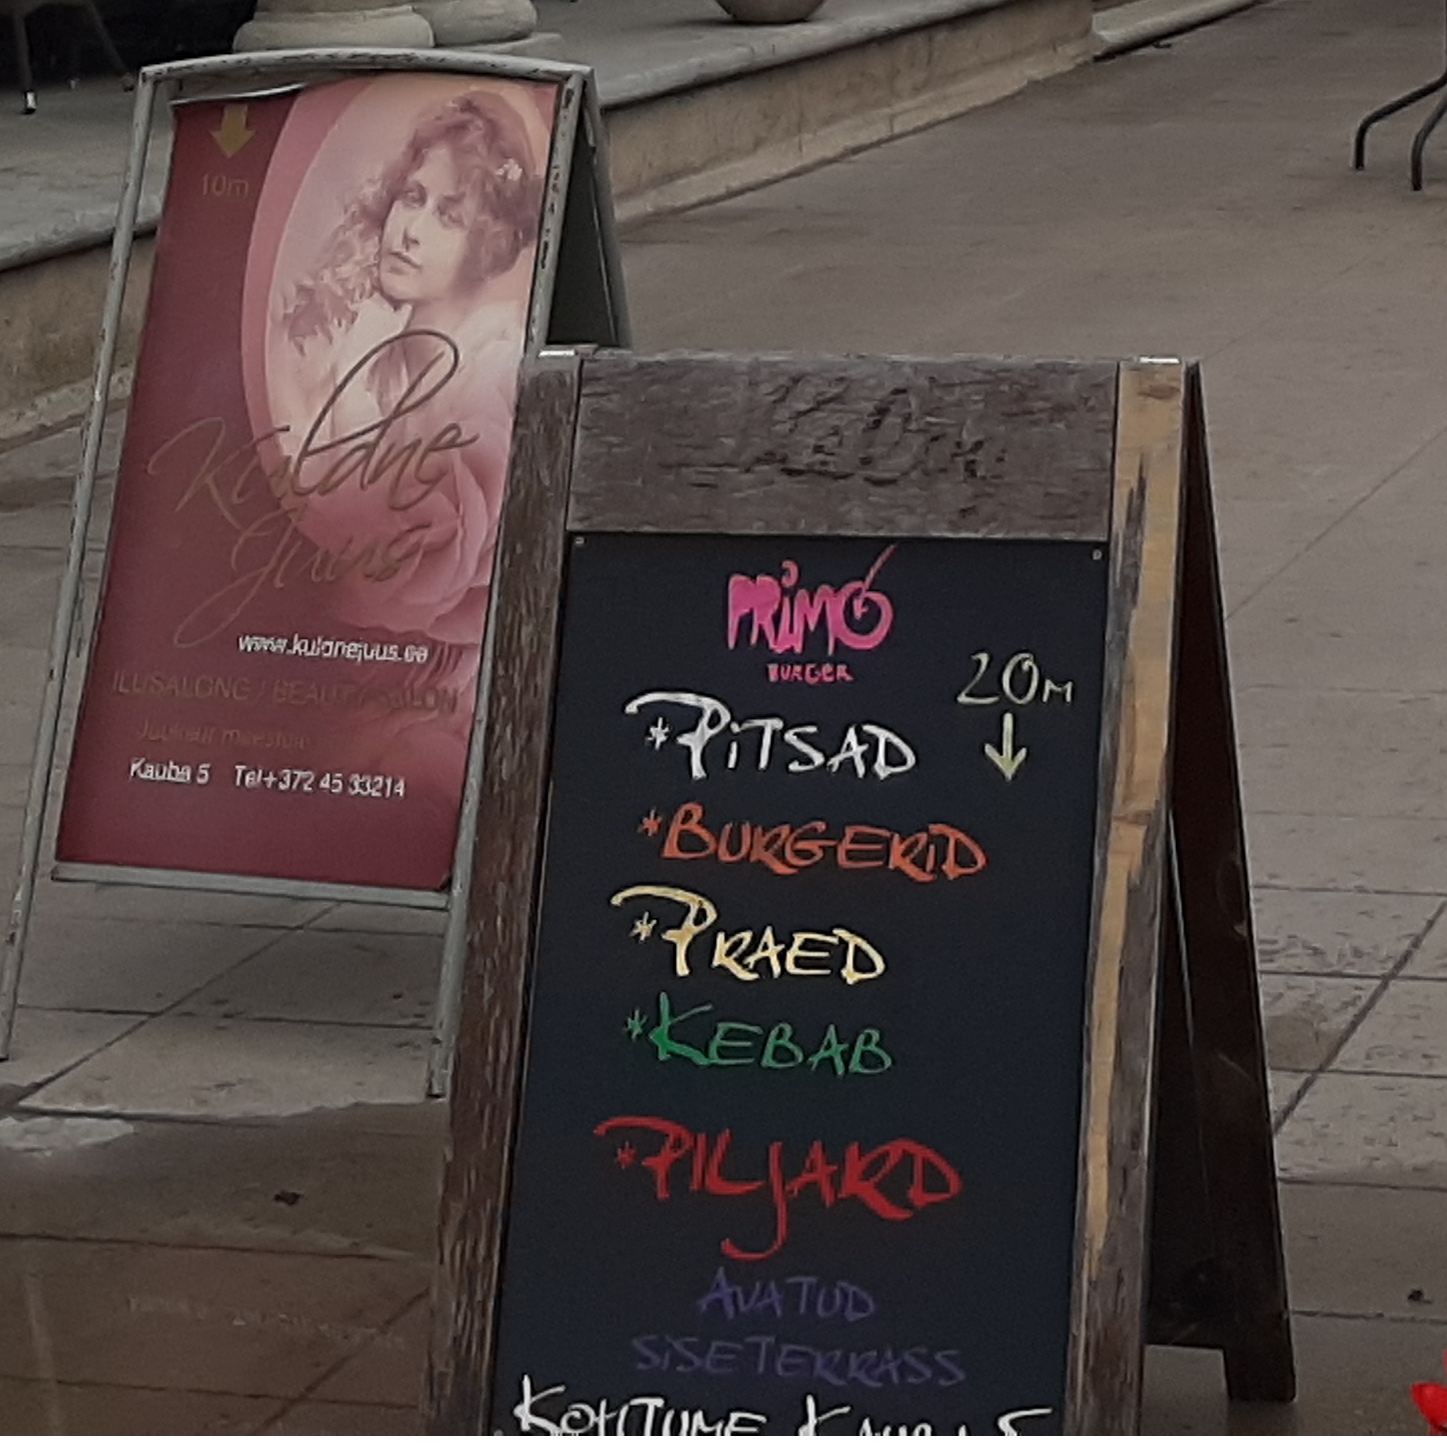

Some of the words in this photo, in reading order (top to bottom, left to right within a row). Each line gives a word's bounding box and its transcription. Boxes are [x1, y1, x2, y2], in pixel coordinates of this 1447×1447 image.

[129, 757, 191, 783] Kauba
[196, 763, 210, 785] 5
[319, 773, 343, 794] 45
